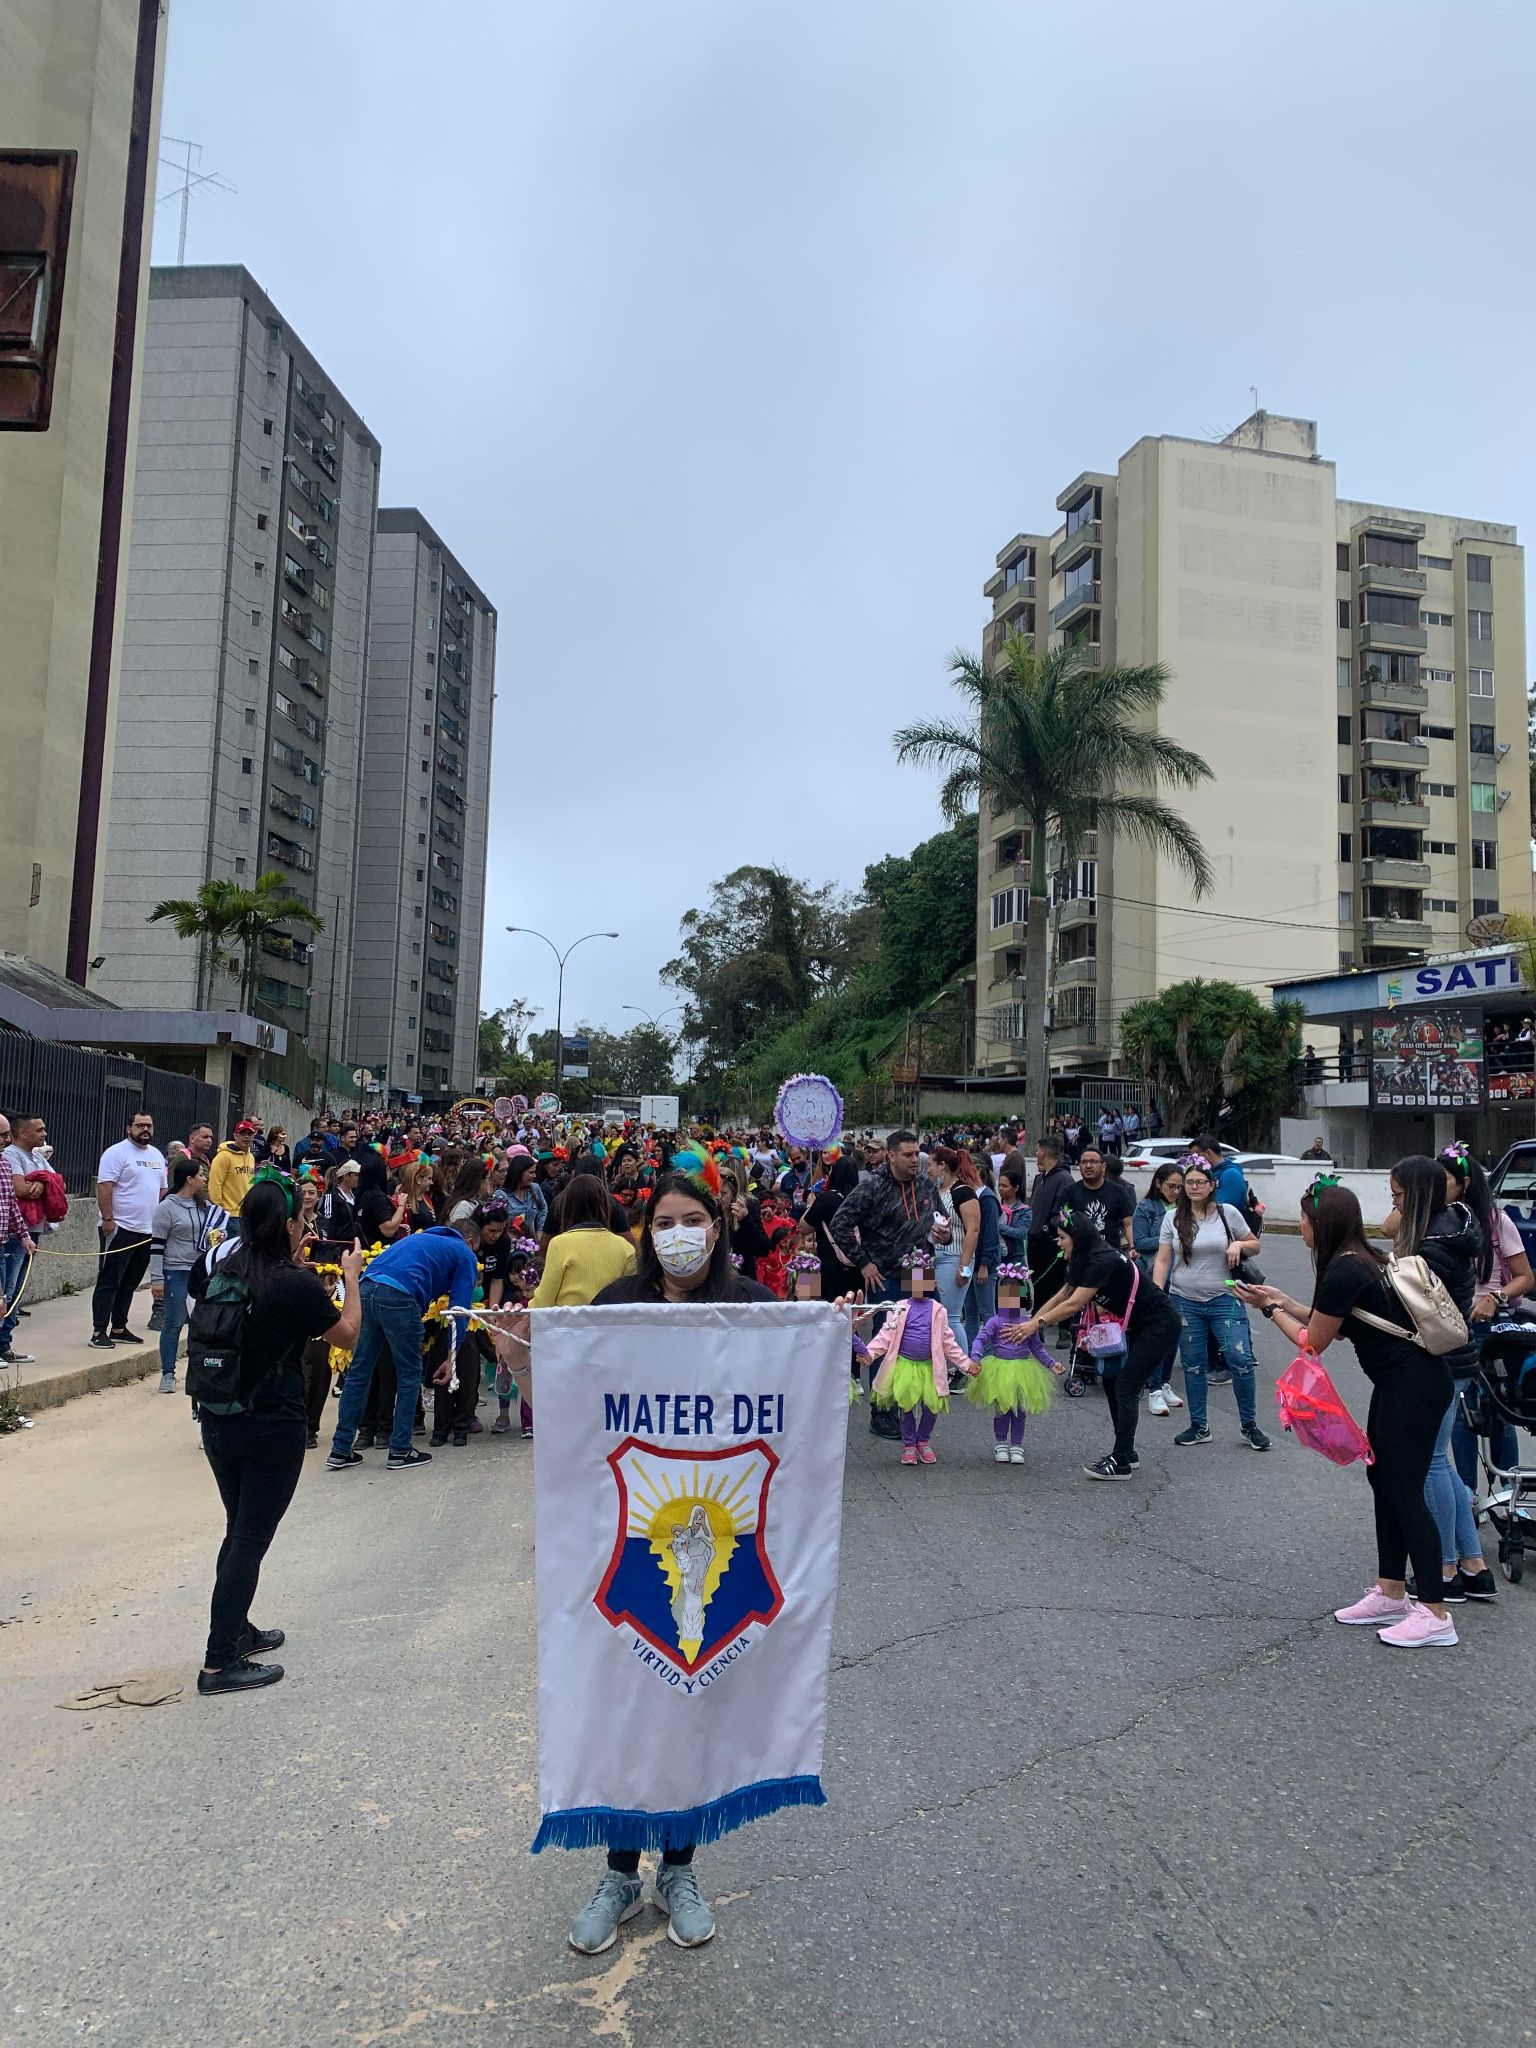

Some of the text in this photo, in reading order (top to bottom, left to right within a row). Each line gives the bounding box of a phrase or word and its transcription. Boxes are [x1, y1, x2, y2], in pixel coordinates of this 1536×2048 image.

[604, 1393, 785, 1436] MATER DEI
[632, 1637, 751, 1694] VIRTUD Y CIENCIA
